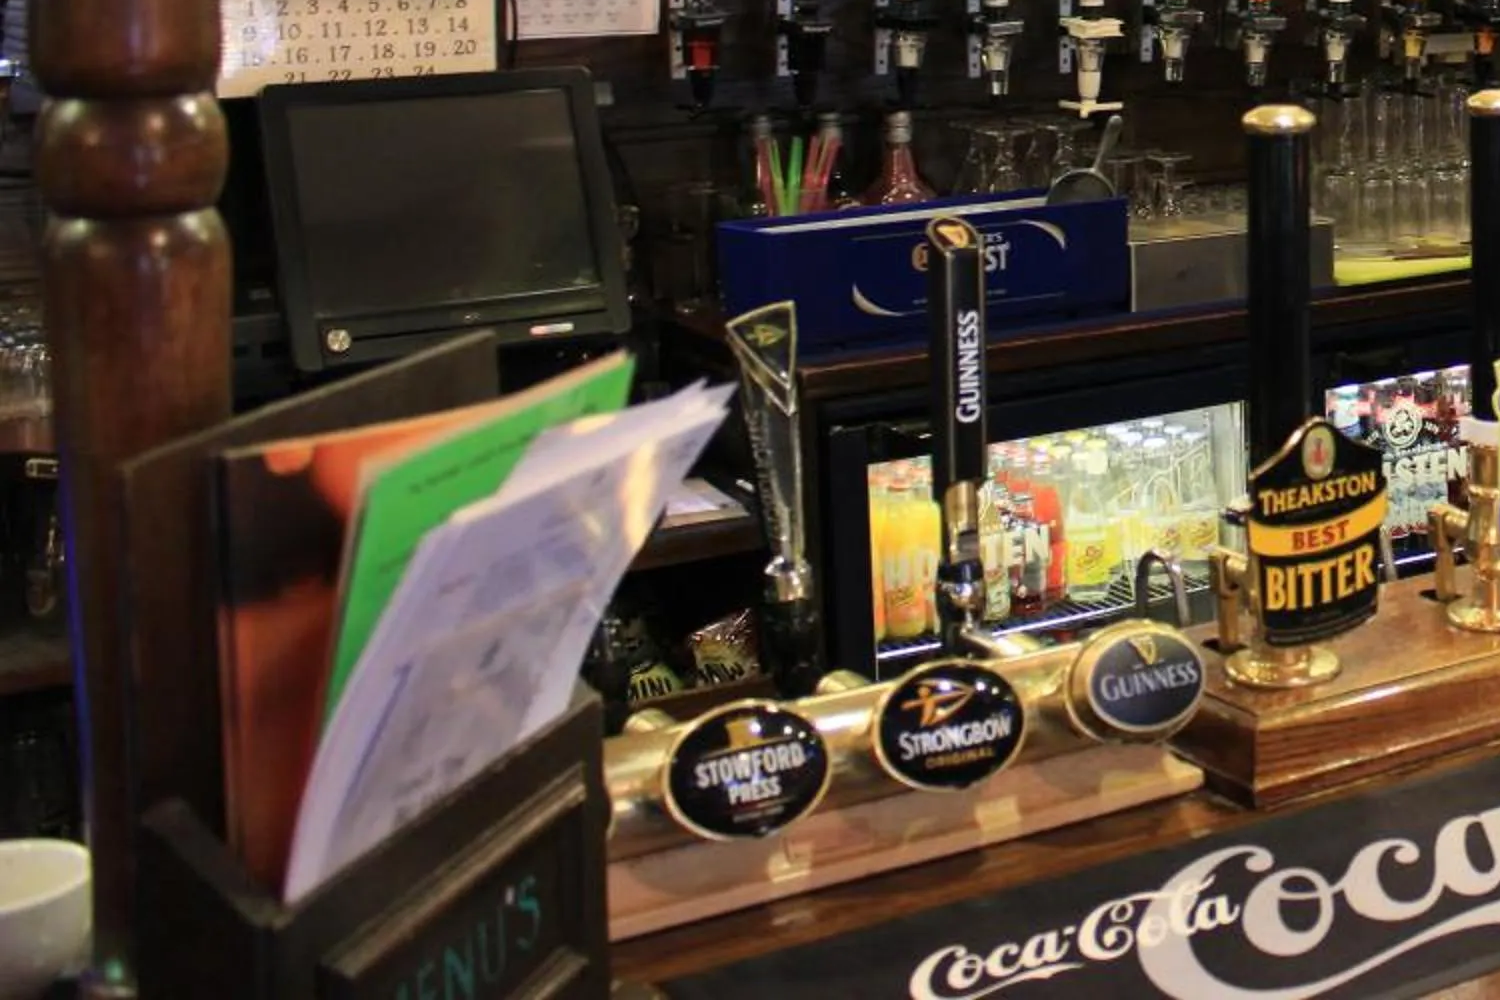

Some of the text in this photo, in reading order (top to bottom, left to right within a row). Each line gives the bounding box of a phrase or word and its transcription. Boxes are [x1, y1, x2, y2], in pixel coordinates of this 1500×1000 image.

[277, 0, 289, 15] 2
[278, 23, 302, 40] 10
[321, 21, 342, 37] 11
[365, 19, 387, 36] 12
[407, 17, 429, 35] 13
[448, 16, 469, 32] 14
[285, 47, 308, 64] 16
[329, 45, 351, 62] 17
[372, 43, 394, 60] 18
[414, 41, 436, 57] 19
[454, 39, 477, 55] 20
[955, 309, 981, 424] GUINNESS
[1381, 447, 1468, 489] LSTEN
[1258, 471, 1376, 516] THEAKSTON
[1292, 519, 1350, 551] BEST
[1266, 544, 1376, 611] BITTER
[1100, 660, 1199, 702] GUINNESS
[898, 712, 1013, 761] STRONGBOW
[693, 741, 807, 789] STOWFORD
[727, 775, 782, 806] PRESS
[396, 874, 542, 1000] ENU'S
[908, 873, 1241, 1000] Coca-Cola
